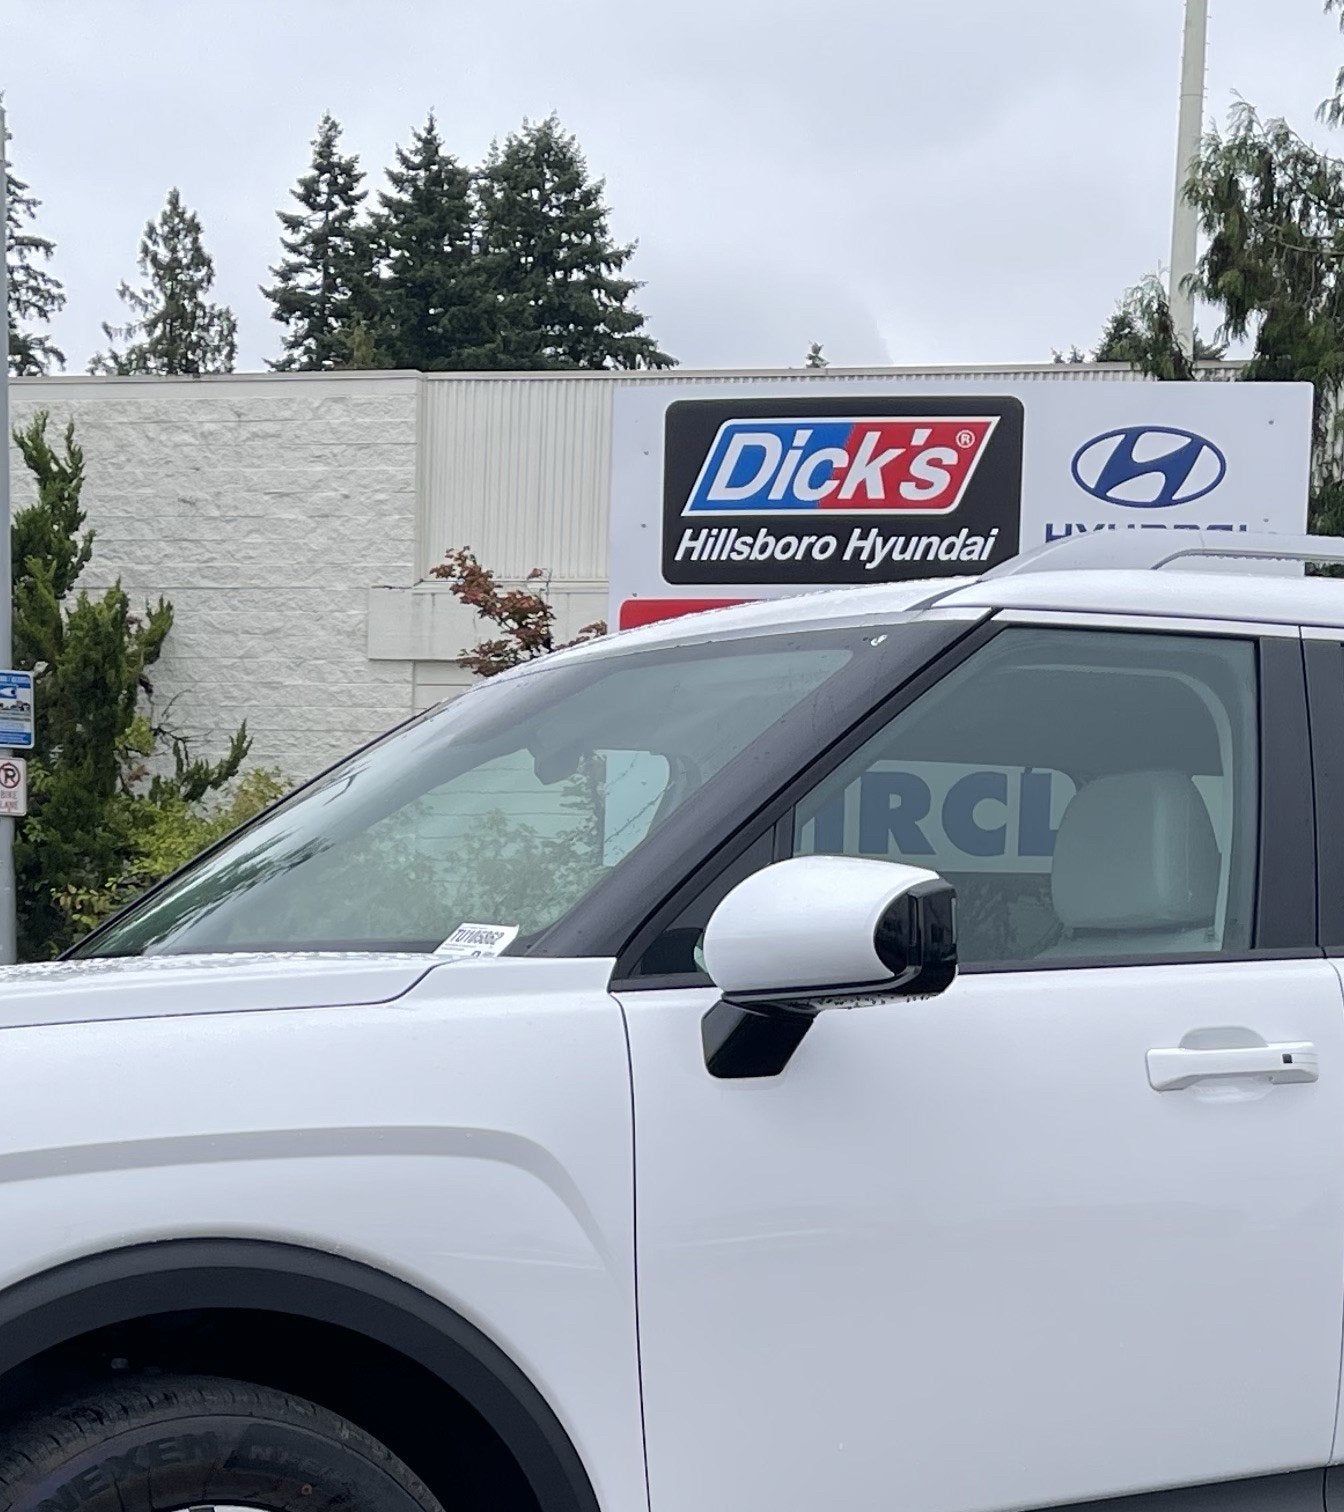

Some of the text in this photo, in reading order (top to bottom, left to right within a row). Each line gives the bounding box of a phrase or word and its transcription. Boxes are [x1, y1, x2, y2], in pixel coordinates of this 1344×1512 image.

[706, 428, 958, 502] Dick's
[674, 528, 999, 570] Hillsboro Hyundai
